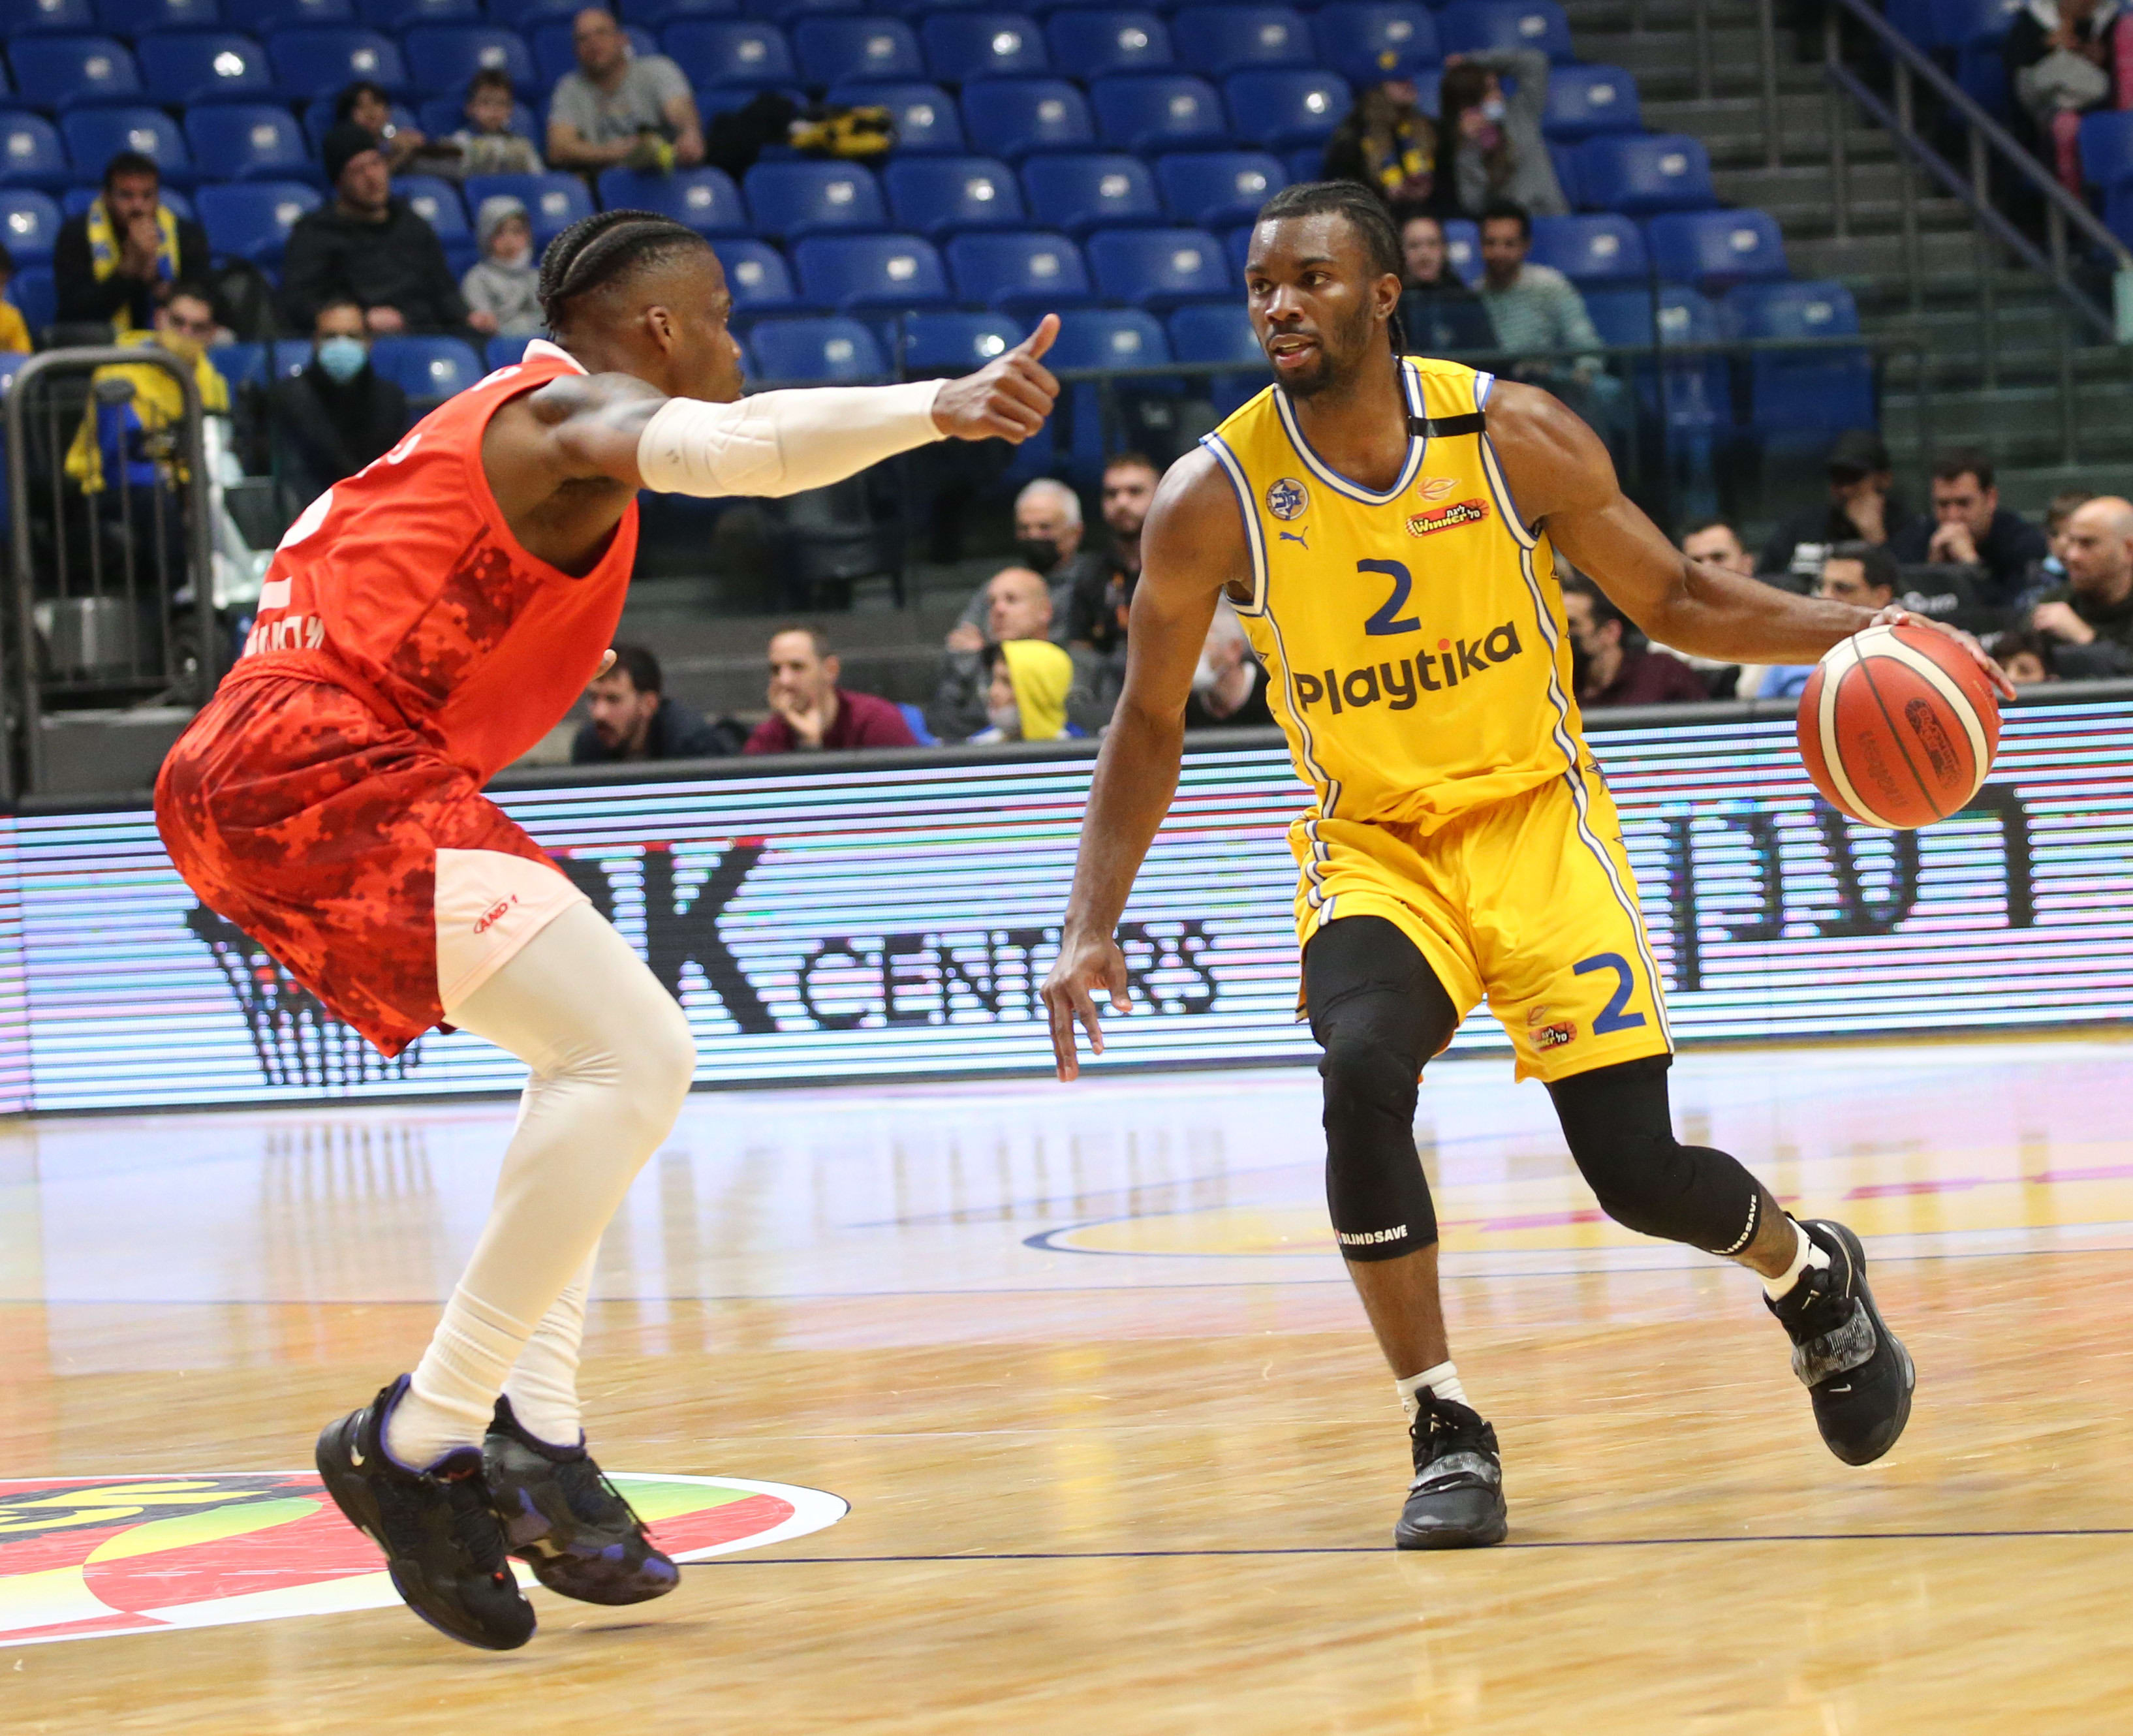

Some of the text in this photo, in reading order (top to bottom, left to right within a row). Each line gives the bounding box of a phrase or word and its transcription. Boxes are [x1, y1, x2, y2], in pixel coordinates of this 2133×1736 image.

[1413, 512, 1467, 533] Winner
[1467, 509, 1480, 519] סל
[1357, 558, 1422, 636] 2
[800, 922, 1217, 1030] CENTRS
[1572, 952, 1646, 1036] 2
